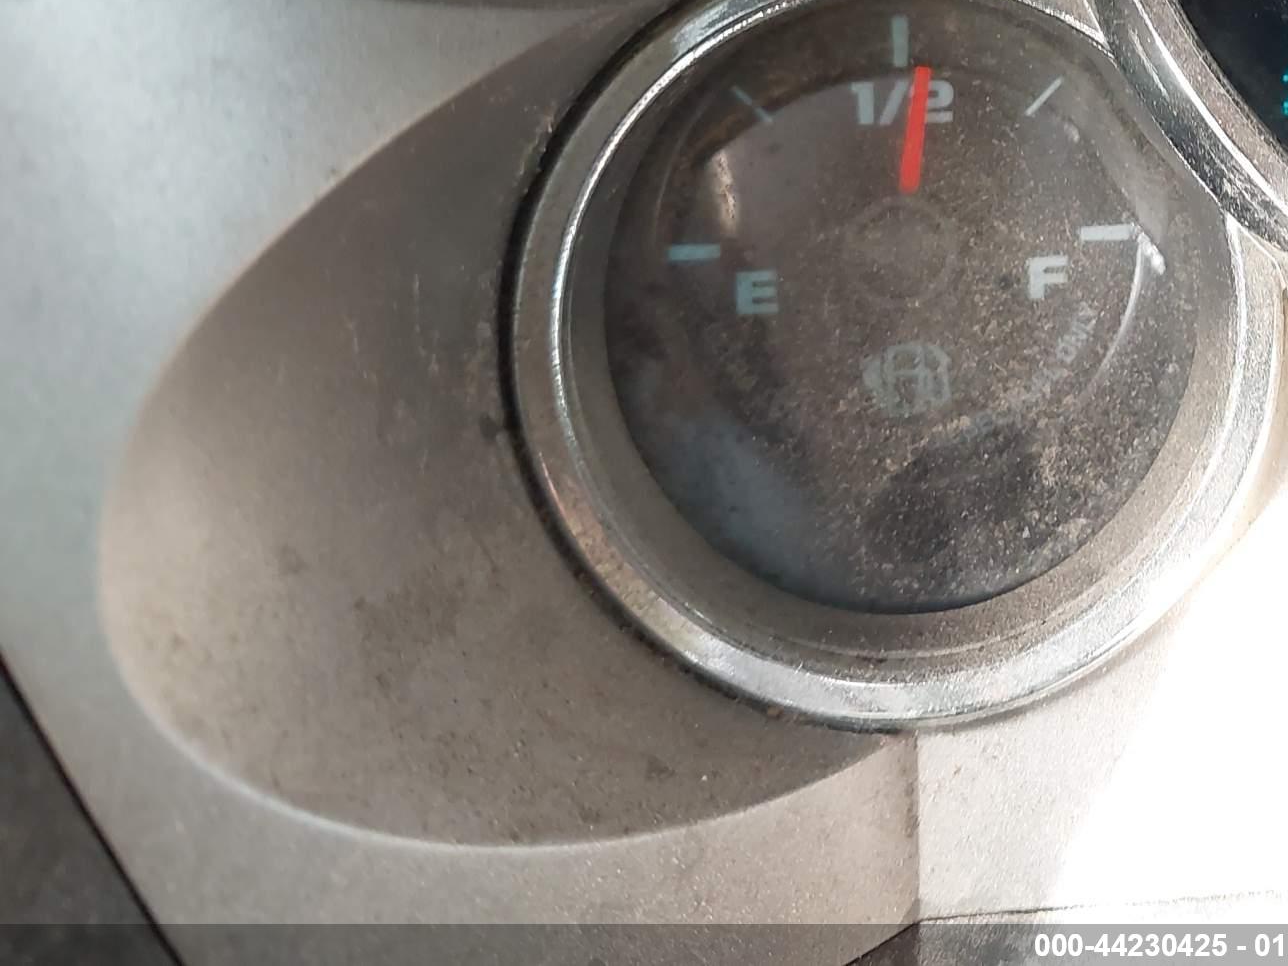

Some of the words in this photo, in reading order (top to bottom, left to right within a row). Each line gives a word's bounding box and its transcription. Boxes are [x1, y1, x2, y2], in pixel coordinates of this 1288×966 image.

[850, 78, 954, 125] 1/2
[736, 269, 779, 314] E
[1027, 254, 1068, 299] F
